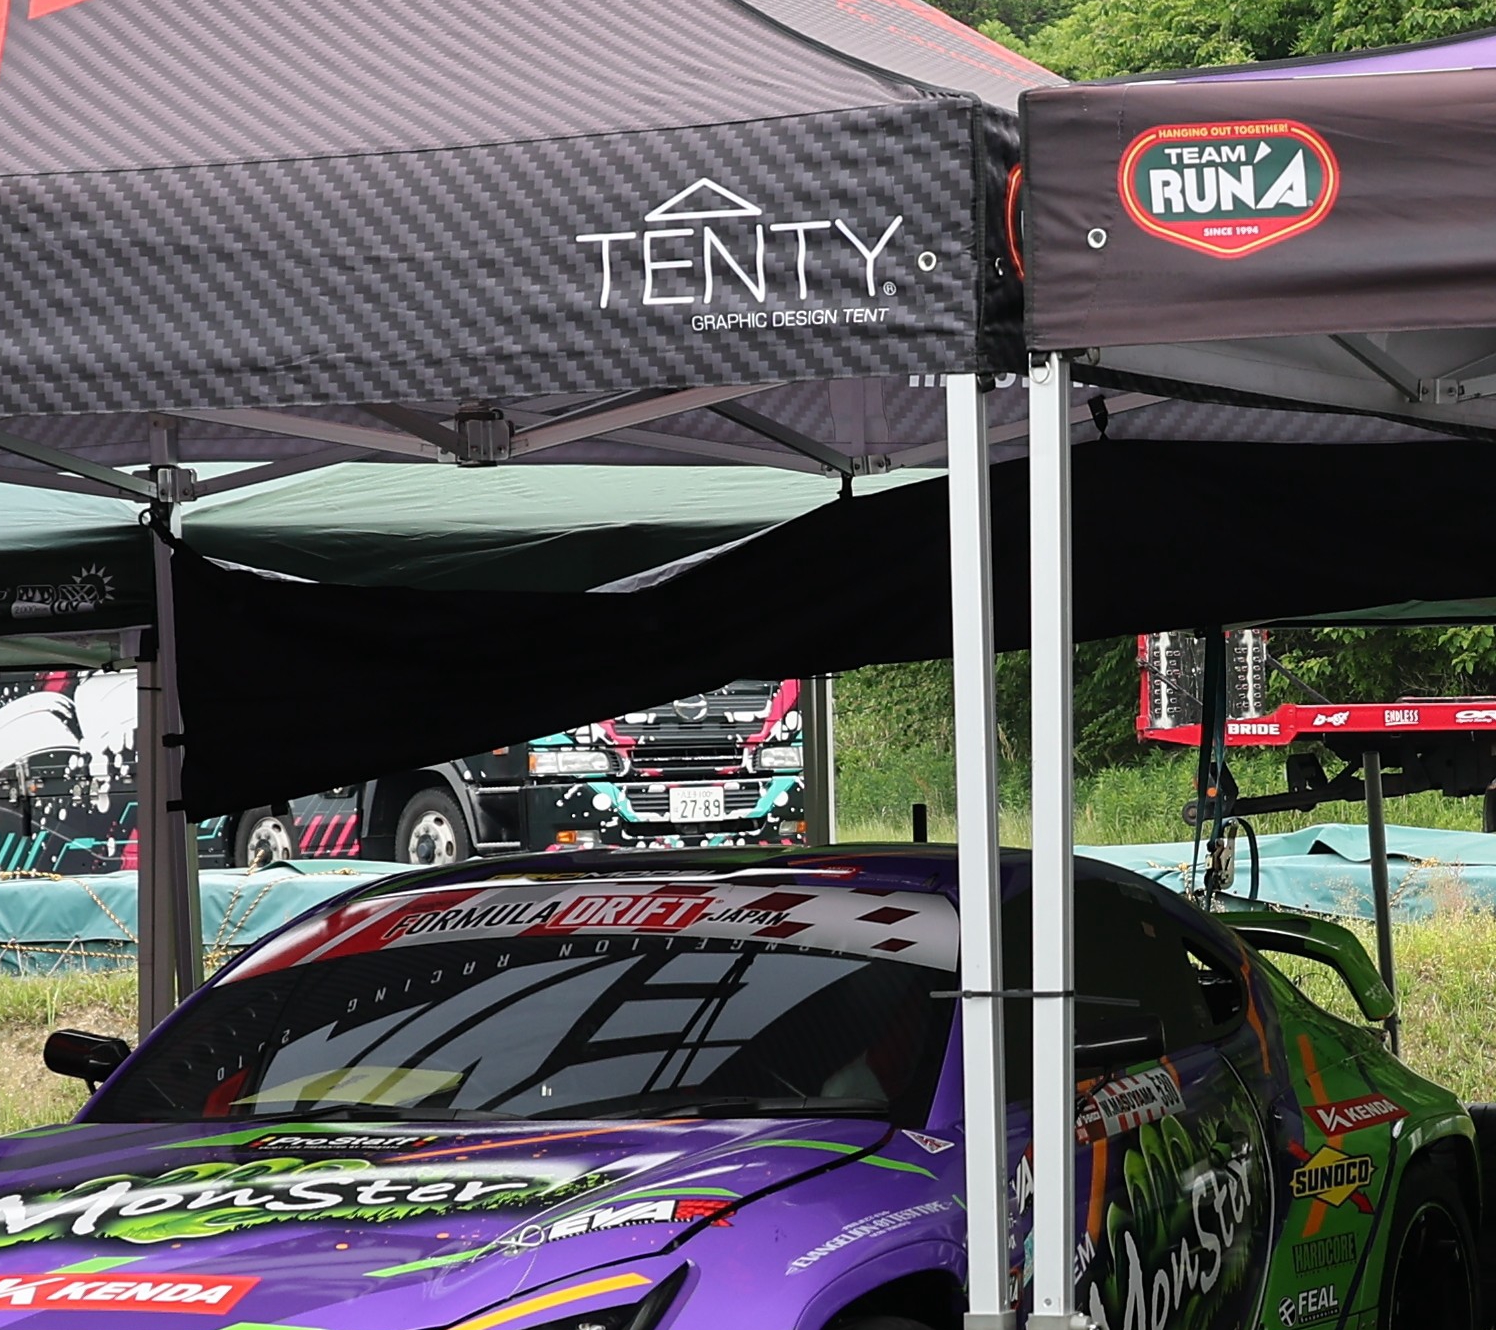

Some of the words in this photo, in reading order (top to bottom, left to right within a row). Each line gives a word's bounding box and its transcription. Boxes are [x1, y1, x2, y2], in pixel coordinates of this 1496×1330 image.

[1158, 126, 1209, 139] HANGING
[1210, 125, 1232, 137] OUT
[1233, 123, 1289, 136] TOGETHER!
[1164, 145, 1246, 165] TEAM
[1203, 226, 1233, 237] SINCE
[1235, 225, 1260, 236] 1994
[576, 215, 903, 310] TENTY
[691, 311, 768, 333] GRAPHIC
[772, 308, 839, 329] DESIGN
[842, 306, 889, 325] TENT
[1227, 723, 1281, 736] BRIDE
[1384, 709, 1420, 724] ENDLESS
[383, 899, 561, 939] FORMULA
[557, 895, 700, 929] DRIFT
[707, 907, 790, 928] JAPAN
[1344, 1097, 1397, 1123] KENDA
[1292, 1155, 1372, 1199] SUNOCO
[1292, 1233, 1356, 1272] HARDCORE
[58, 1278, 230, 1307] KENDA
[1298, 1283, 1339, 1316] FEAL
